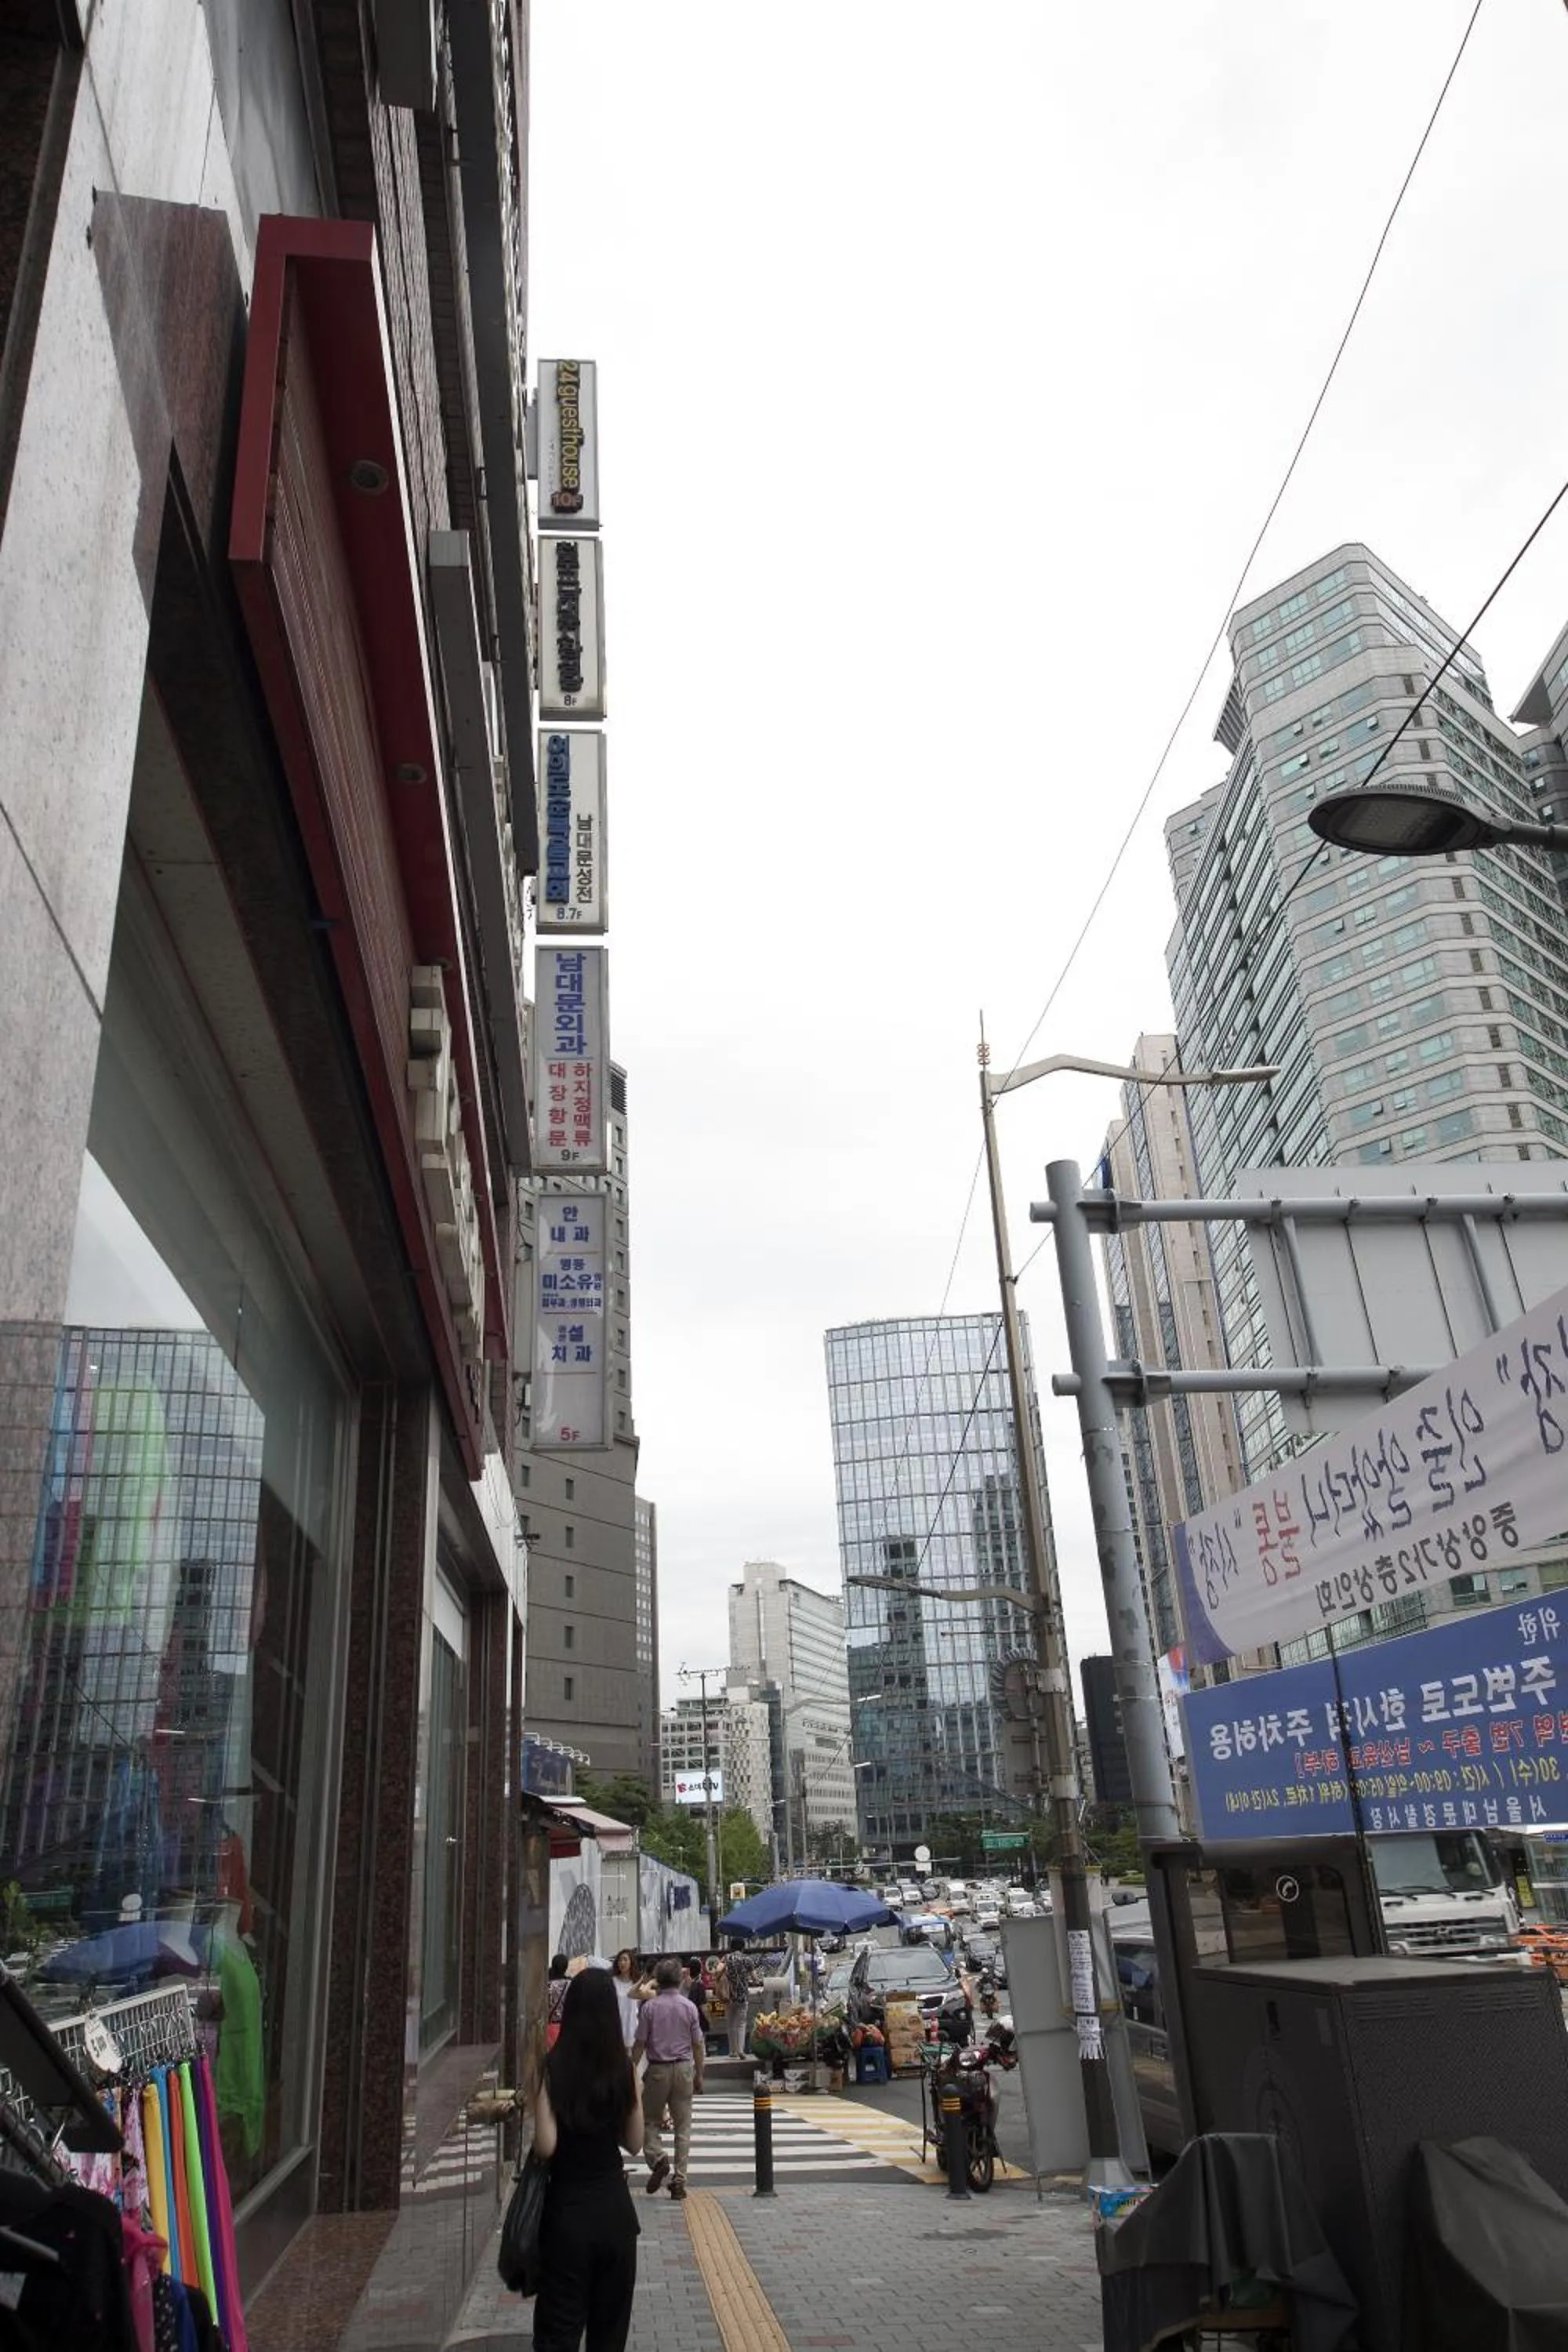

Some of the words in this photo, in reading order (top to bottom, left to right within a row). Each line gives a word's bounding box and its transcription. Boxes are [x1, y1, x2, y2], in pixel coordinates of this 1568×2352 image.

[564, 695, 578, 706] 8F
[576, 813, 593, 904] 남대문성전
[554, 953, 587, 1055] 남대문외과
[548, 1062, 568, 1147] 대장항문
[572, 1062, 593, 1147] 하지정맥류
[561, 1149, 580, 1161] 9F
[562, 1205, 578, 1222] 안
[543, 1273, 593, 1290] 미소유
[551, 1345, 592, 1363] 치과
[561, 1428, 580, 1441] 5F
